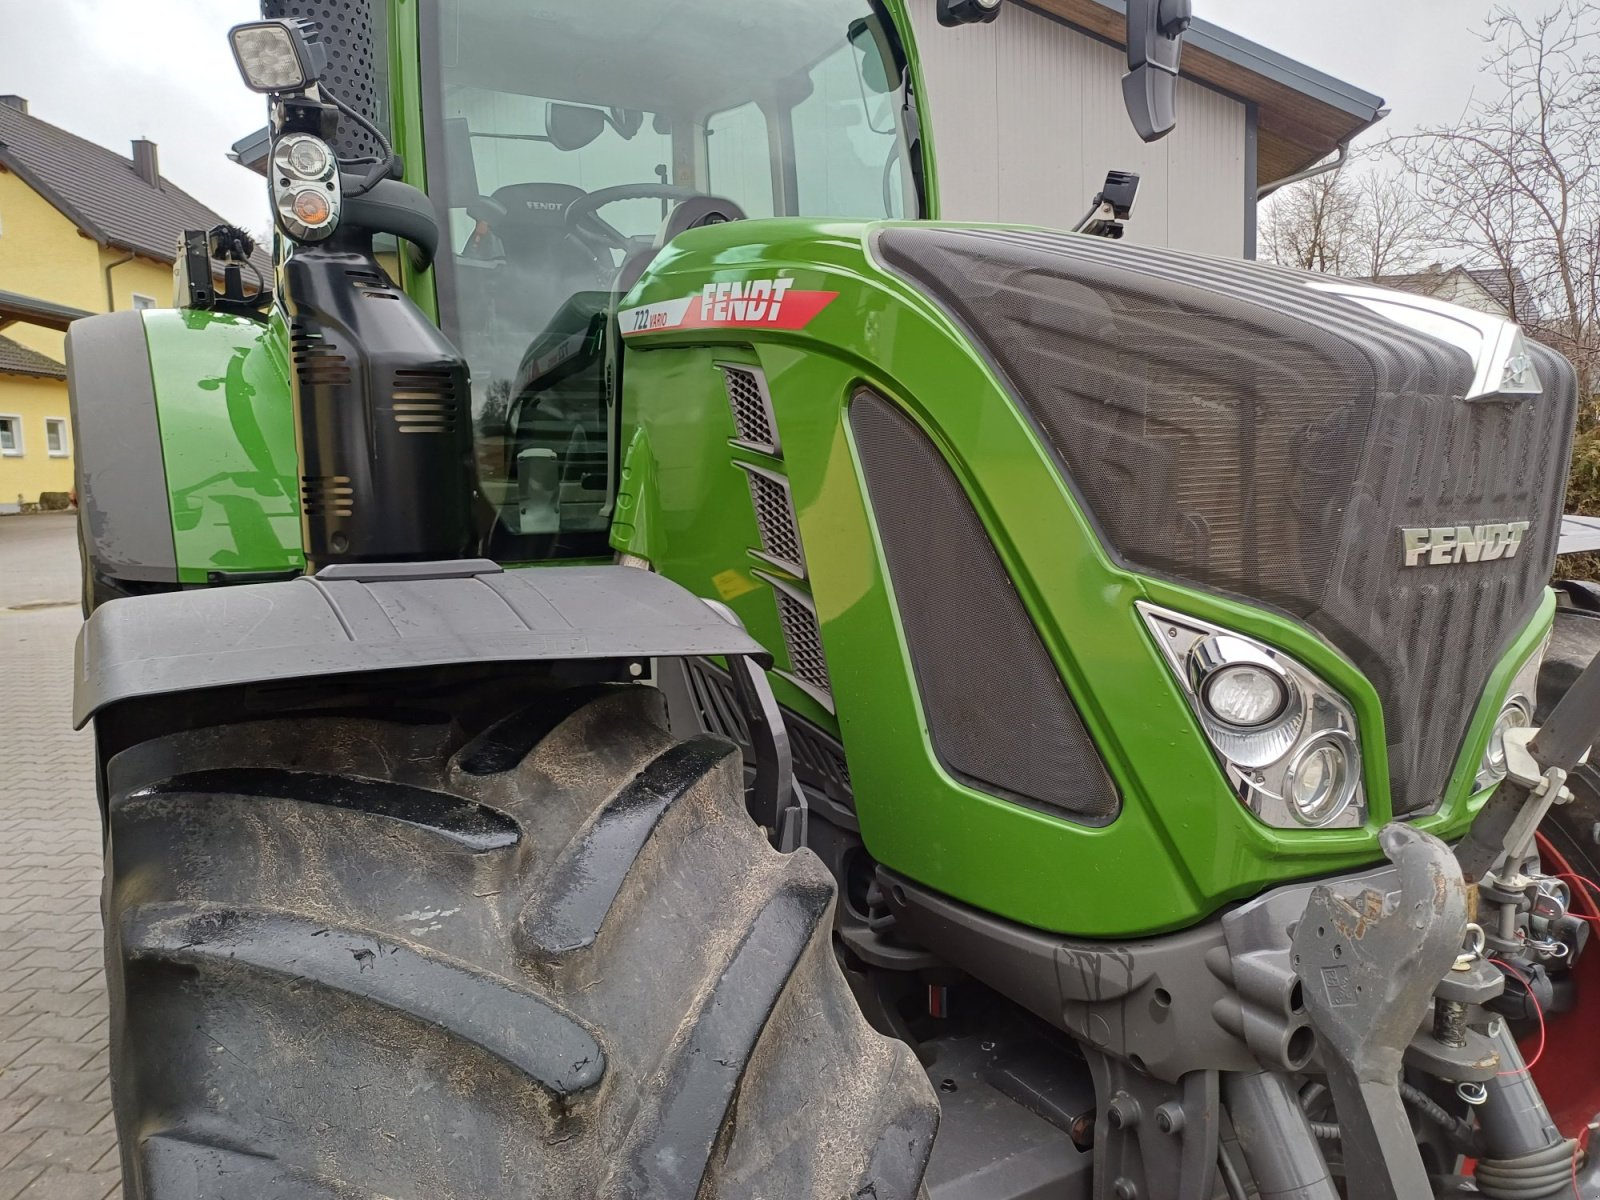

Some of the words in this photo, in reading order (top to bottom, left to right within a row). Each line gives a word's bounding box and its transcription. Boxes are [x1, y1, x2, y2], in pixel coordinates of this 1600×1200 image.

[526, 201, 563, 211] FENDT
[633, 309, 650, 331] 722
[650, 311, 668, 328] VARIO
[701, 277, 795, 322] FENDT
[1402, 520, 1531, 567] FENDT
